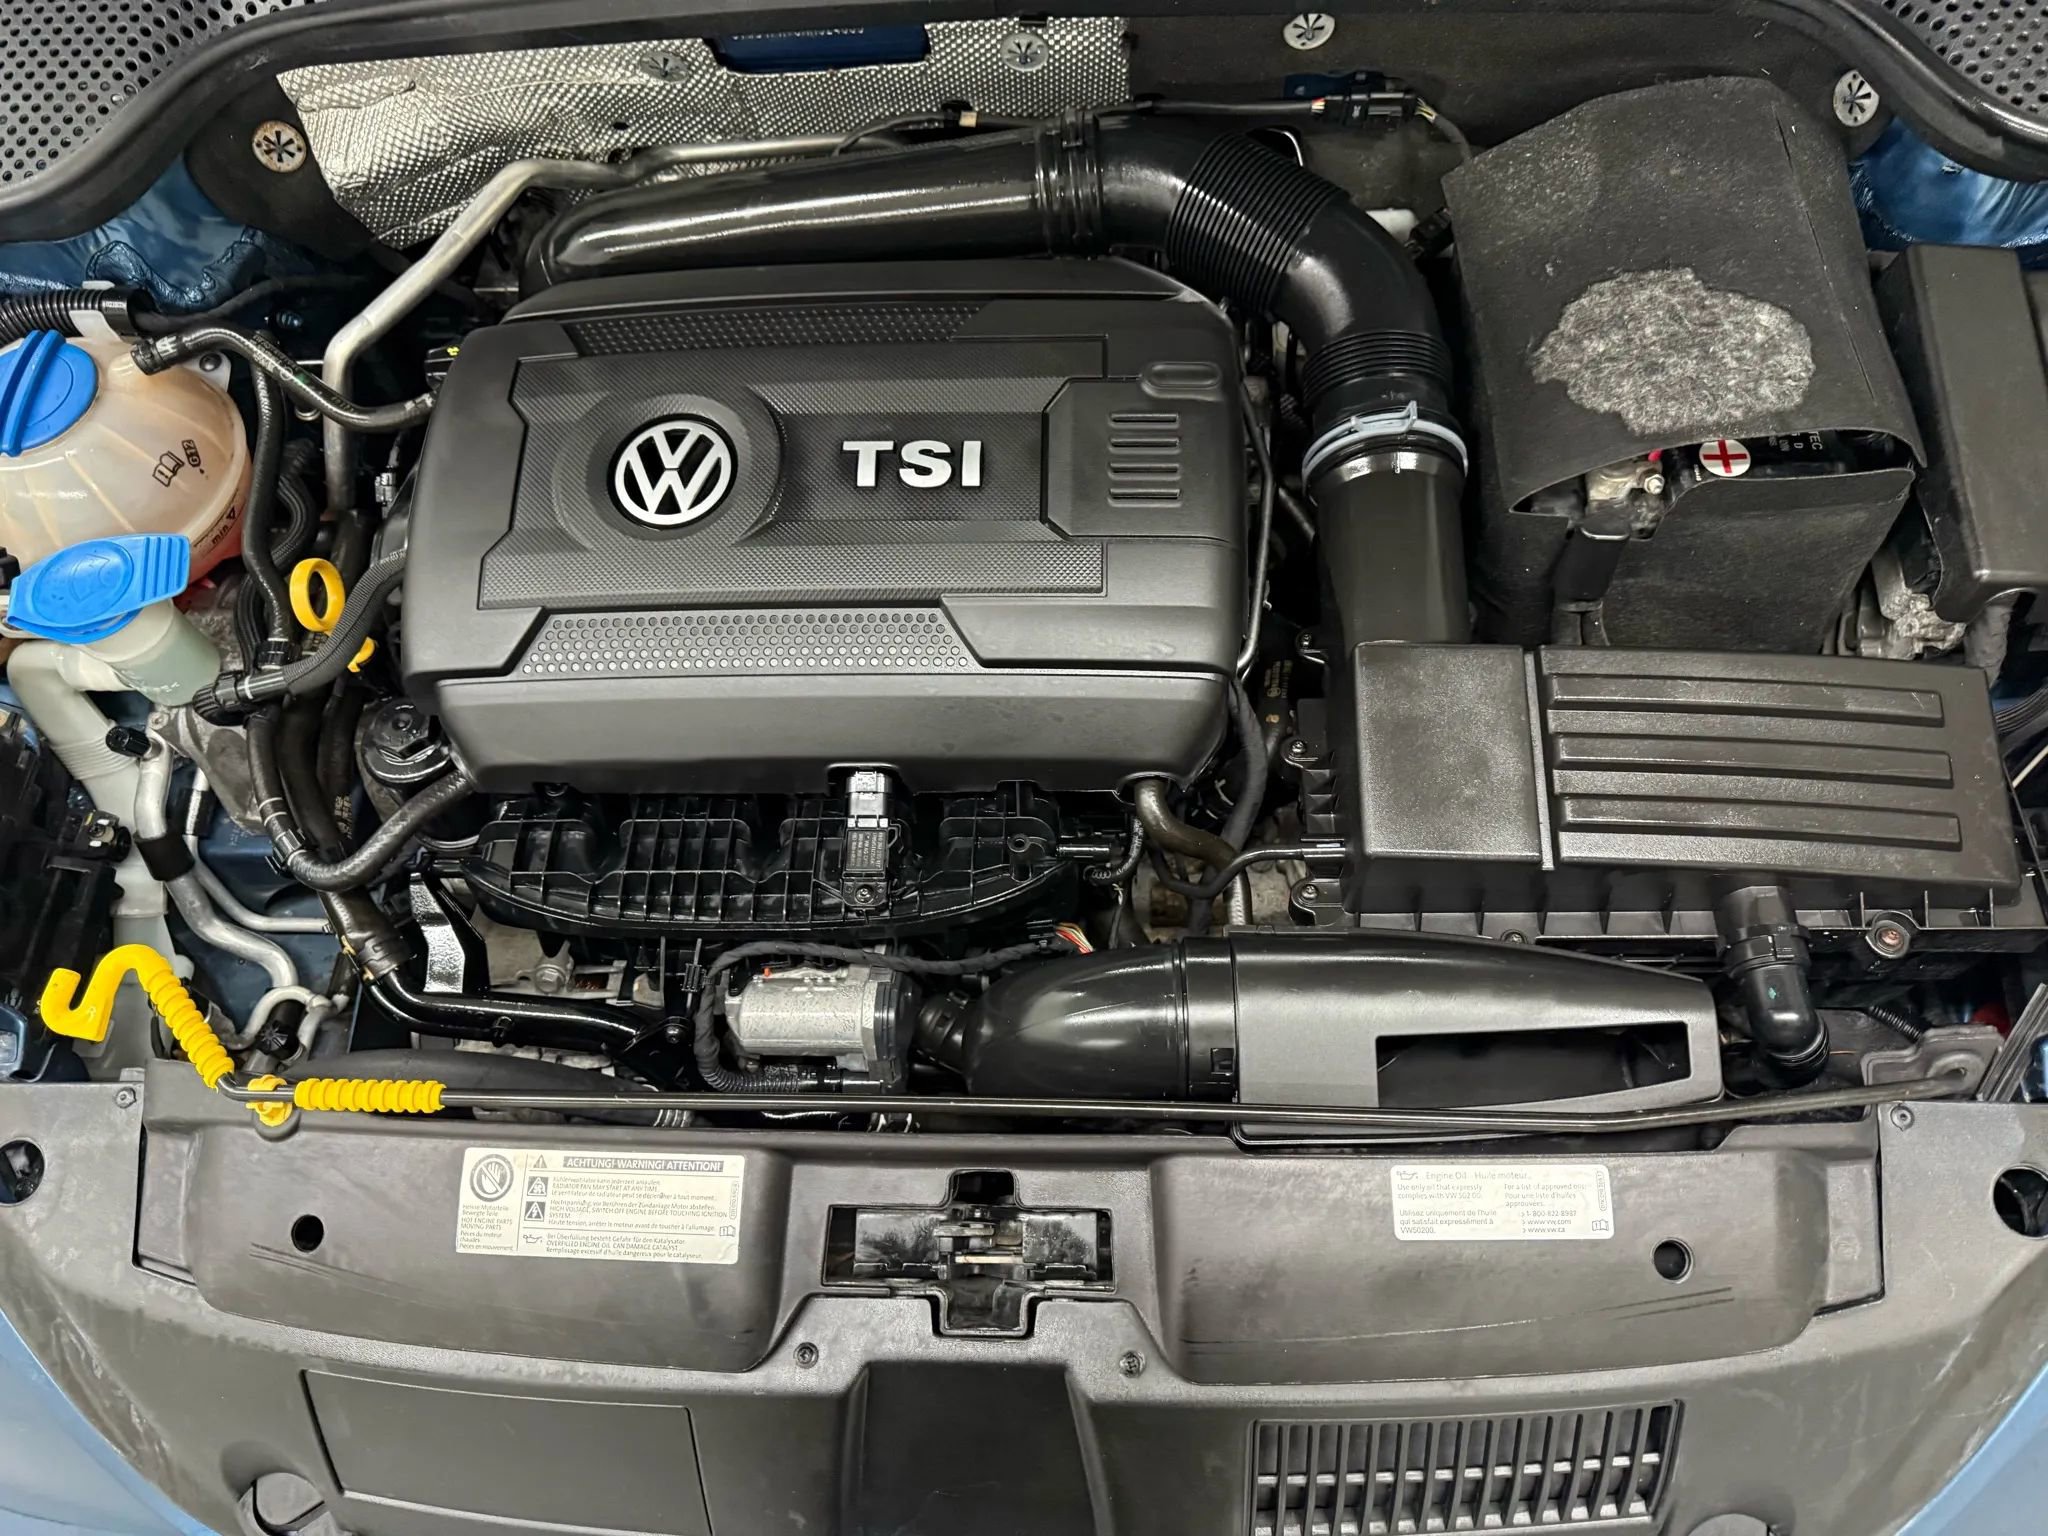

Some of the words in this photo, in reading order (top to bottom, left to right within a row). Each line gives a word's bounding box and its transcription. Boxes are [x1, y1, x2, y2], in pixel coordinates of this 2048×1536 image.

[183, 440, 200, 467] G12
[843, 440, 982, 488] TSI
[615, 420, 731, 525] VW
[211, 524, 229, 544] min
[567, 1158, 614, 1168] ACHTUNG!
[617, 1159, 664, 1170] WARNING!
[666, 1160, 721, 1171] ATTENTION!
[1426, 1172, 1453, 1182] Engine
